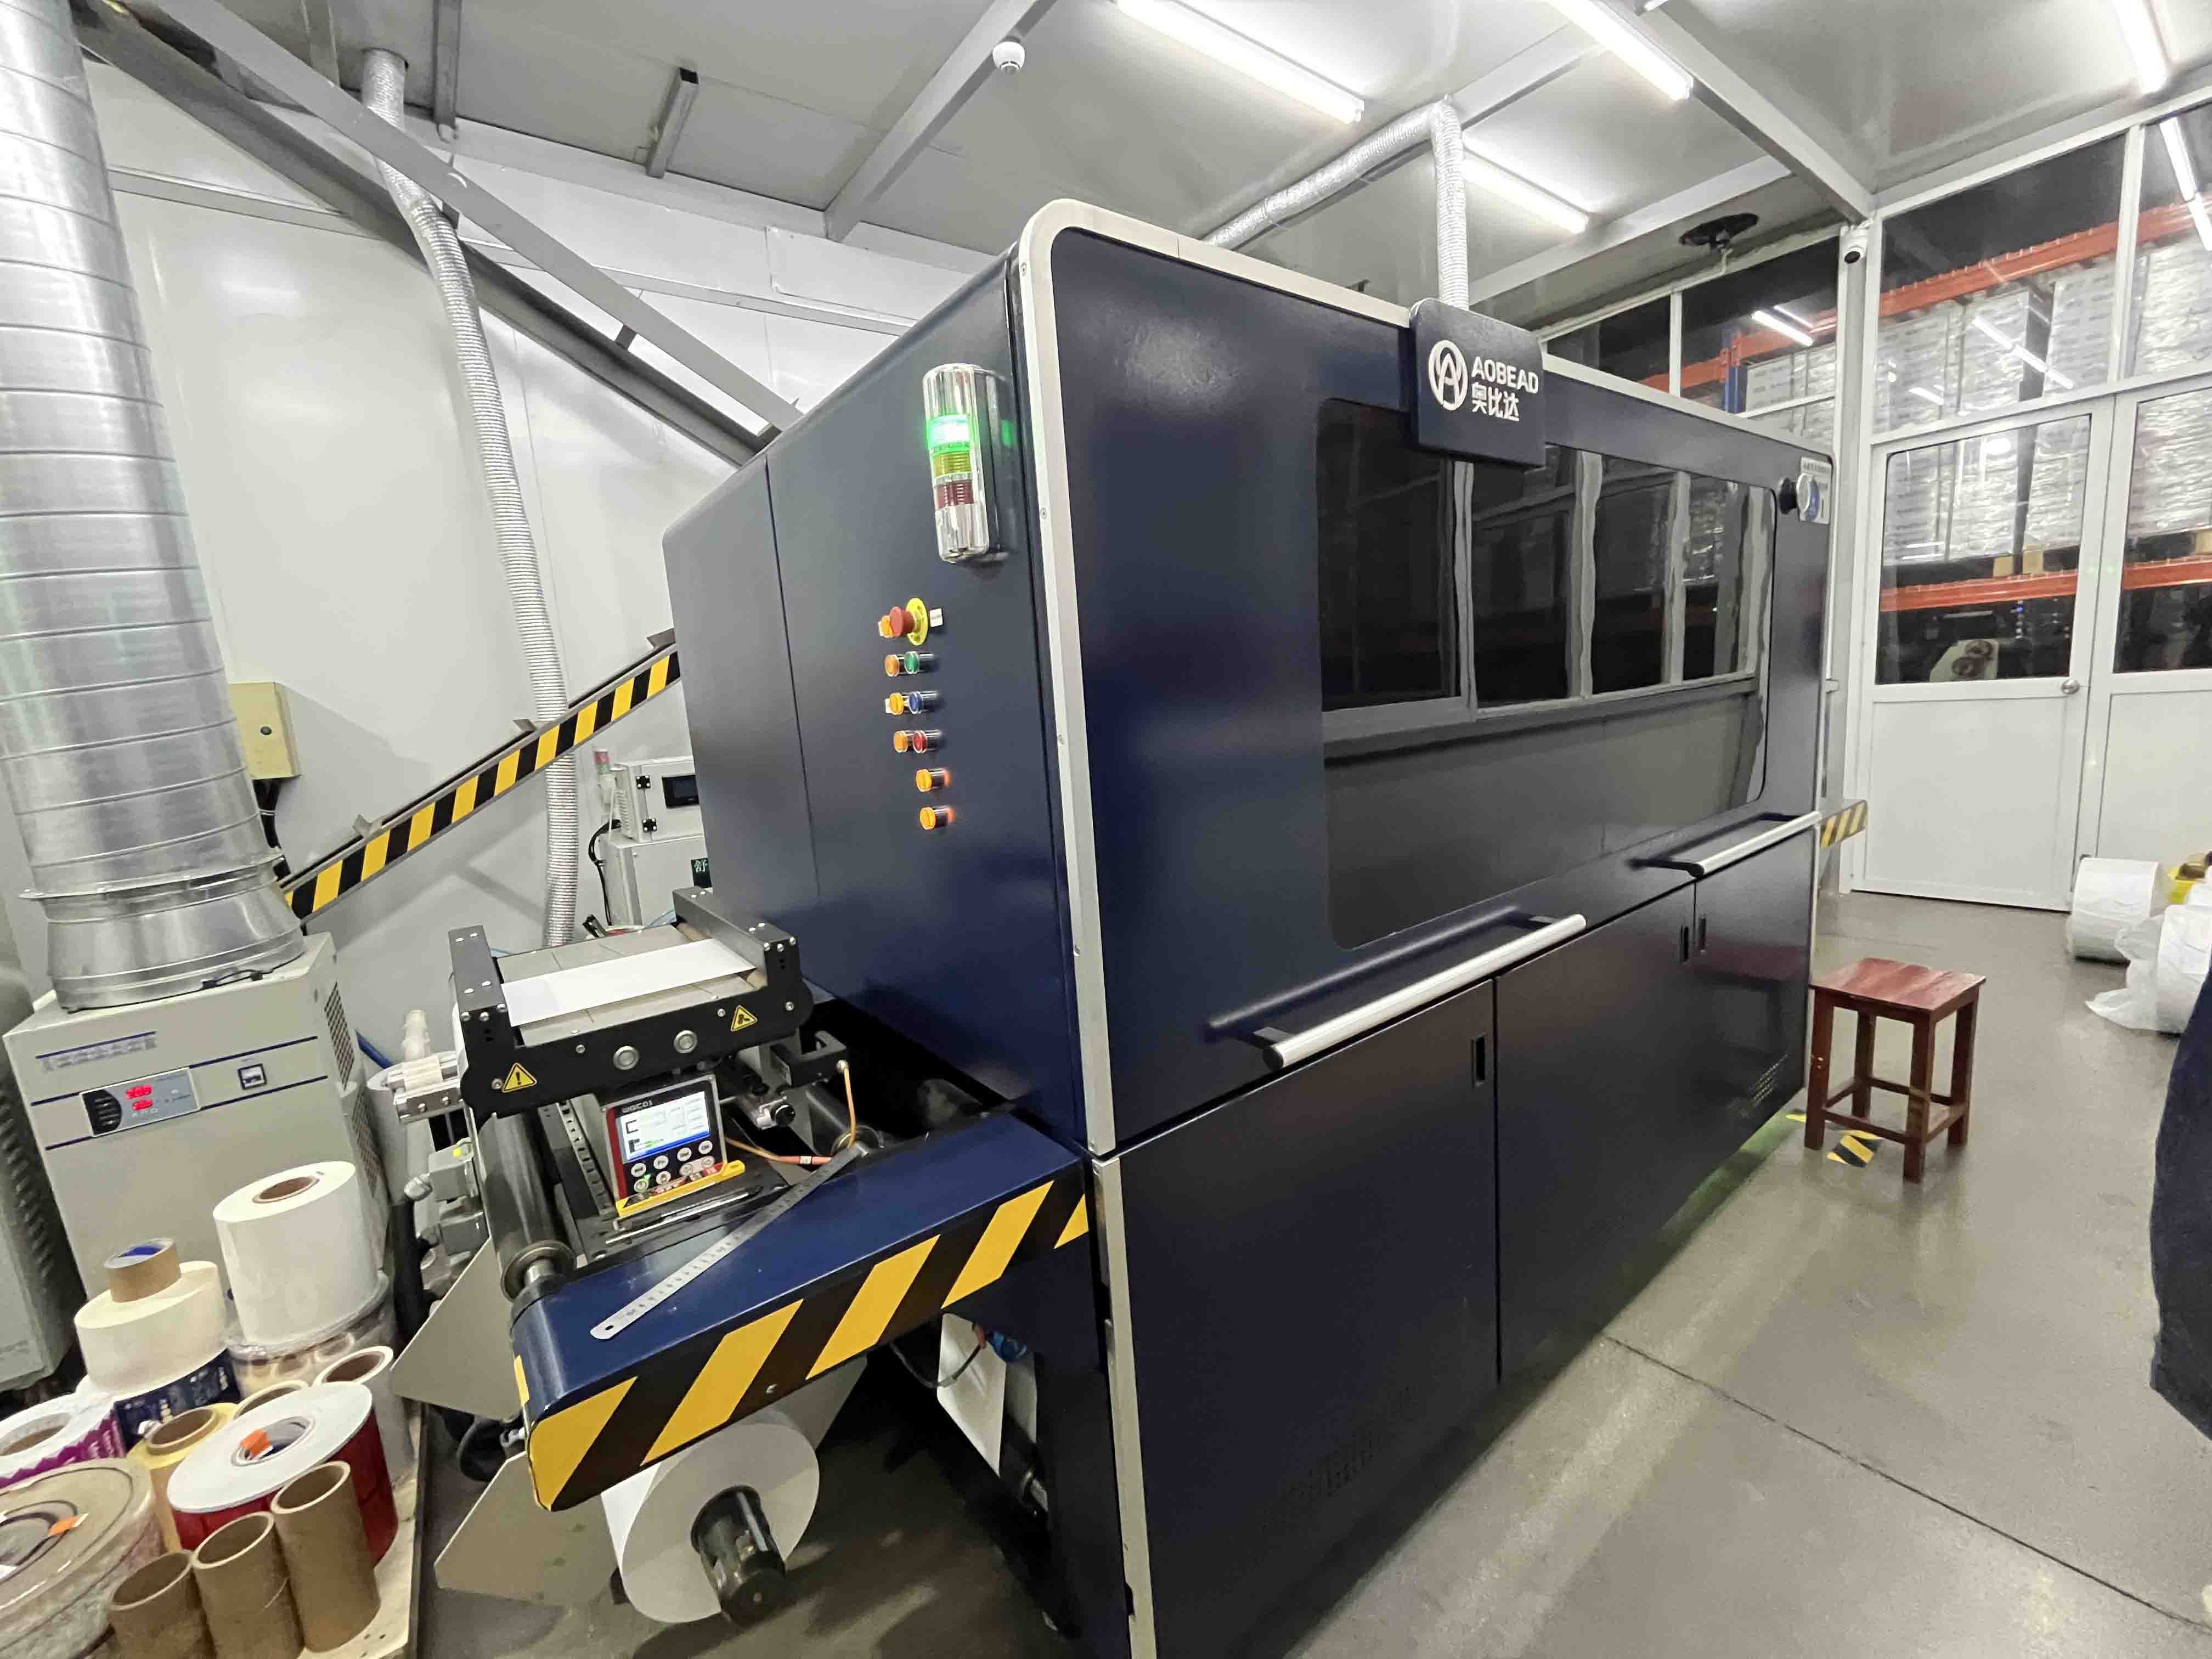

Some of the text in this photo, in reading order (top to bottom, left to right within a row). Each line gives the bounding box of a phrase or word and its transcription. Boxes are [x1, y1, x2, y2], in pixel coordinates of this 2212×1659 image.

[1471, 356, 1539, 394] AOBEAD
[1471, 382, 1520, 422] 奥比达
